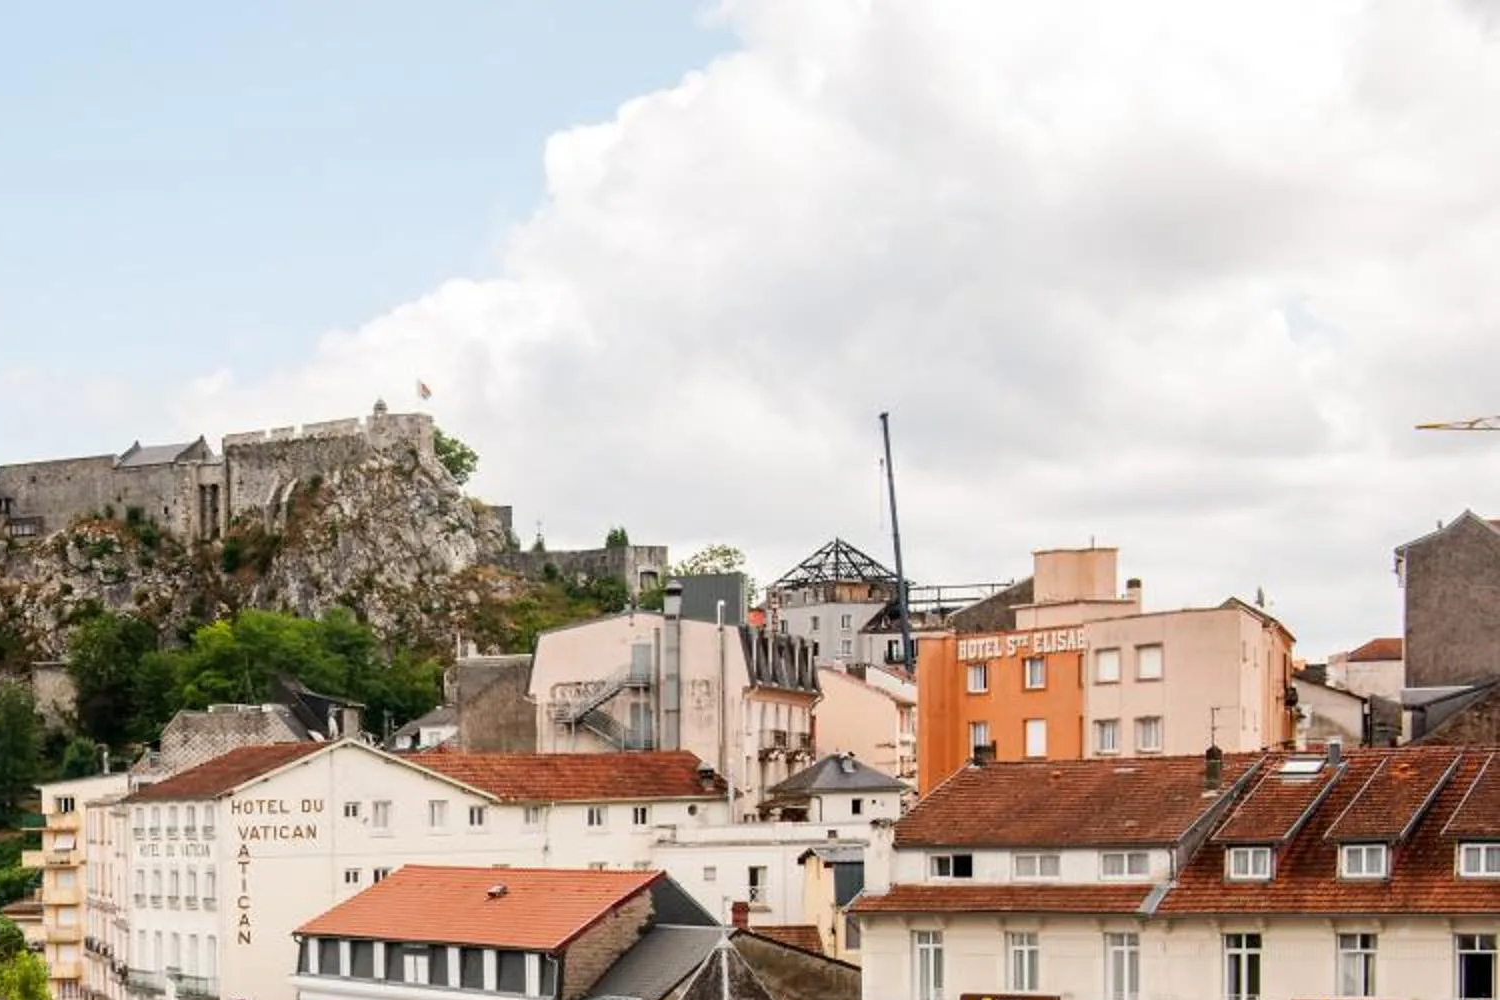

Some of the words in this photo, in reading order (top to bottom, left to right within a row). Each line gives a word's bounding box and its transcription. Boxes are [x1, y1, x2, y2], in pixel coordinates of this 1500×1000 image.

[957, 636, 1002, 661] HOTEL
[231, 799, 290, 815] HOTEL
[301, 799, 325, 814] DU
[237, 824, 317, 841] VATICAN
